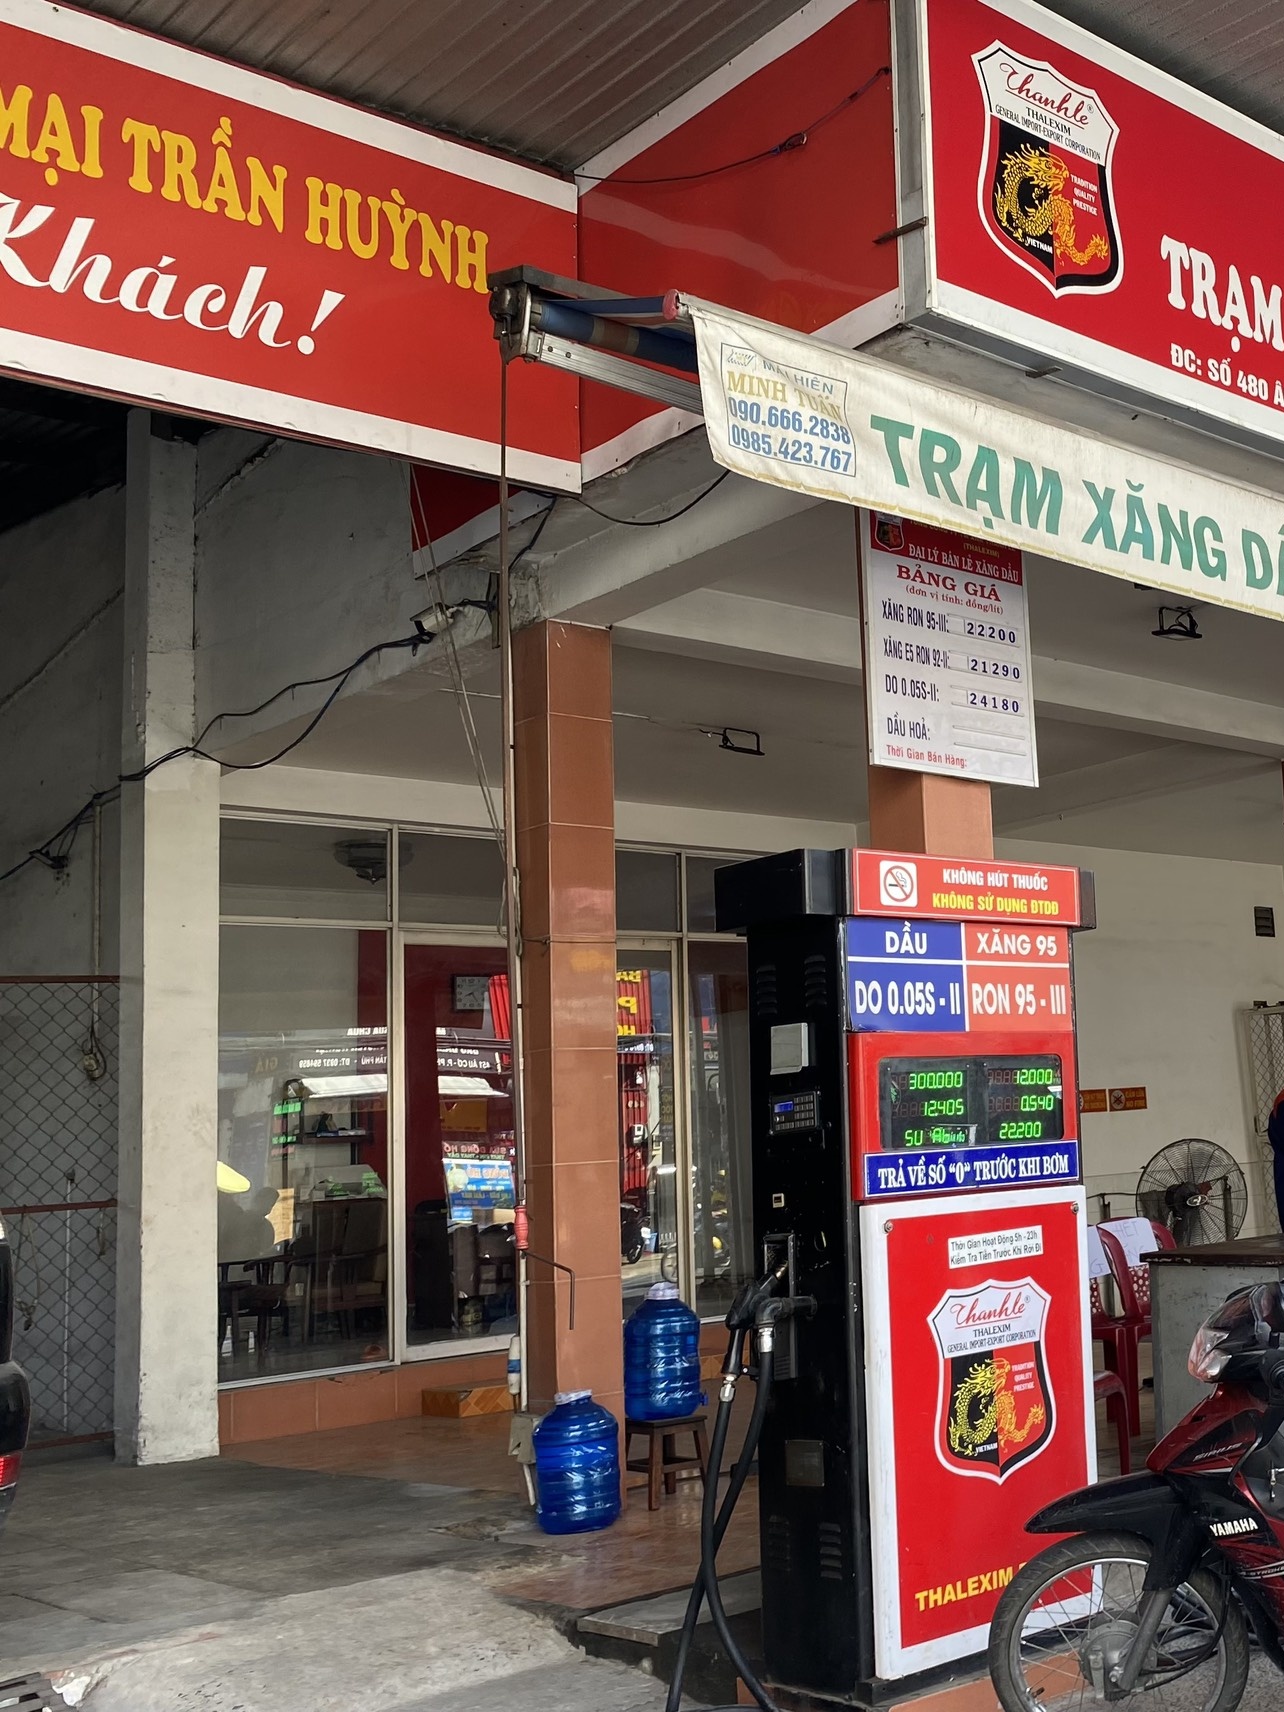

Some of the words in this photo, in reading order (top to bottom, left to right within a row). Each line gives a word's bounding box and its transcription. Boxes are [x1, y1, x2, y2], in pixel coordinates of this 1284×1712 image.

[995, 104, 1020, 124] GENERAL
[1065, 136, 1101, 160] CORPORATION
[1026, 106, 1071, 136] THALEXIM
[1070, 173, 1098, 192] TRADITION
[1073, 187, 1095, 203] QUALITY
[121, 116, 287, 233] TRẦN
[304, 176, 489, 294] HUỲNH
[1072, 198, 1097, 216] PRESTIGE
[1027, 236, 1052, 254] VIETNAM
[0, 190, 346, 356] Khách!
[727, 370, 788, 402] MINH
[1170, 342, 1202, 375] ĐC:
[1207, 357, 1232, 387] SỐ
[1237, 370, 1269, 401] 480
[728, 397, 851, 445] 090.666.2838
[731, 423, 852, 473] 0985.423.767
[870, 414, 1064, 536] TRẠM
[1081, 479, 1229, 582] XĂNG
[908, 544, 926, 560] ĐẠI
[928, 546, 940, 562] LÝ
[975, 559, 1000, 578] XĂNG
[1001, 563, 1019, 583] DẦU
[897, 564, 957, 592] BẢNG
[964, 583, 1001, 602] GIÁ
[882, 598, 904, 623] XĂNG
[907, 606, 924, 627] RON
[967, 622, 1016, 643] 22200
[883, 635, 902, 660] XĂNG
[905, 643, 914, 661] E5
[916, 645, 930, 665] RON
[970, 659, 1020, 679] 21290
[885, 674, 898, 694] DO
[970, 692, 1019, 713] 24180
[887, 711, 906, 736] DẦU
[907, 748, 924, 760] Gian
[927, 751, 942, 763] Bán
[943, 867, 984, 887] KHÔNG
[987, 870, 1009, 888] HÚT
[1012, 871, 1048, 891] THUỐC
[932, 891, 974, 911] KHÔNG
[978, 892, 994, 911] SỬ
[996, 896, 1028, 916] DỤNG
[1030, 900, 1059, 916] ĐTDĐ
[885, 920, 927, 954] DẦU
[976, 928, 1031, 955] XĂNG
[1036, 935, 1057, 956] 95
[855, 980, 882, 1014] DO
[887, 981, 935, 1015] 0.05S
[949, 982, 961, 1015] II
[972, 983, 1010, 1015] RON
[1015, 984, 1036, 1015] 95
[1050, 984, 1066, 1015] III
[878, 1158, 907, 1189] TRẢ
[908, 1156, 926, 1185] VỀ
[928, 1155, 946, 1183] SỐ
[974, 1155, 1017, 1181] TRƯỚC
[1019, 1157, 1040, 1176] KHI
[1043, 1152, 1069, 1175] BƠM
[967, 1240, 981, 1250] Gian
[1027, 1230, 1037, 1240] 23h
[968, 1253, 977, 1262] Tra
[973, 1323, 1011, 1338] THALEXIM
[1210, 1518, 1258, 1537] YAMAHA
[915, 1565, 1013, 1611] THALEXIM
